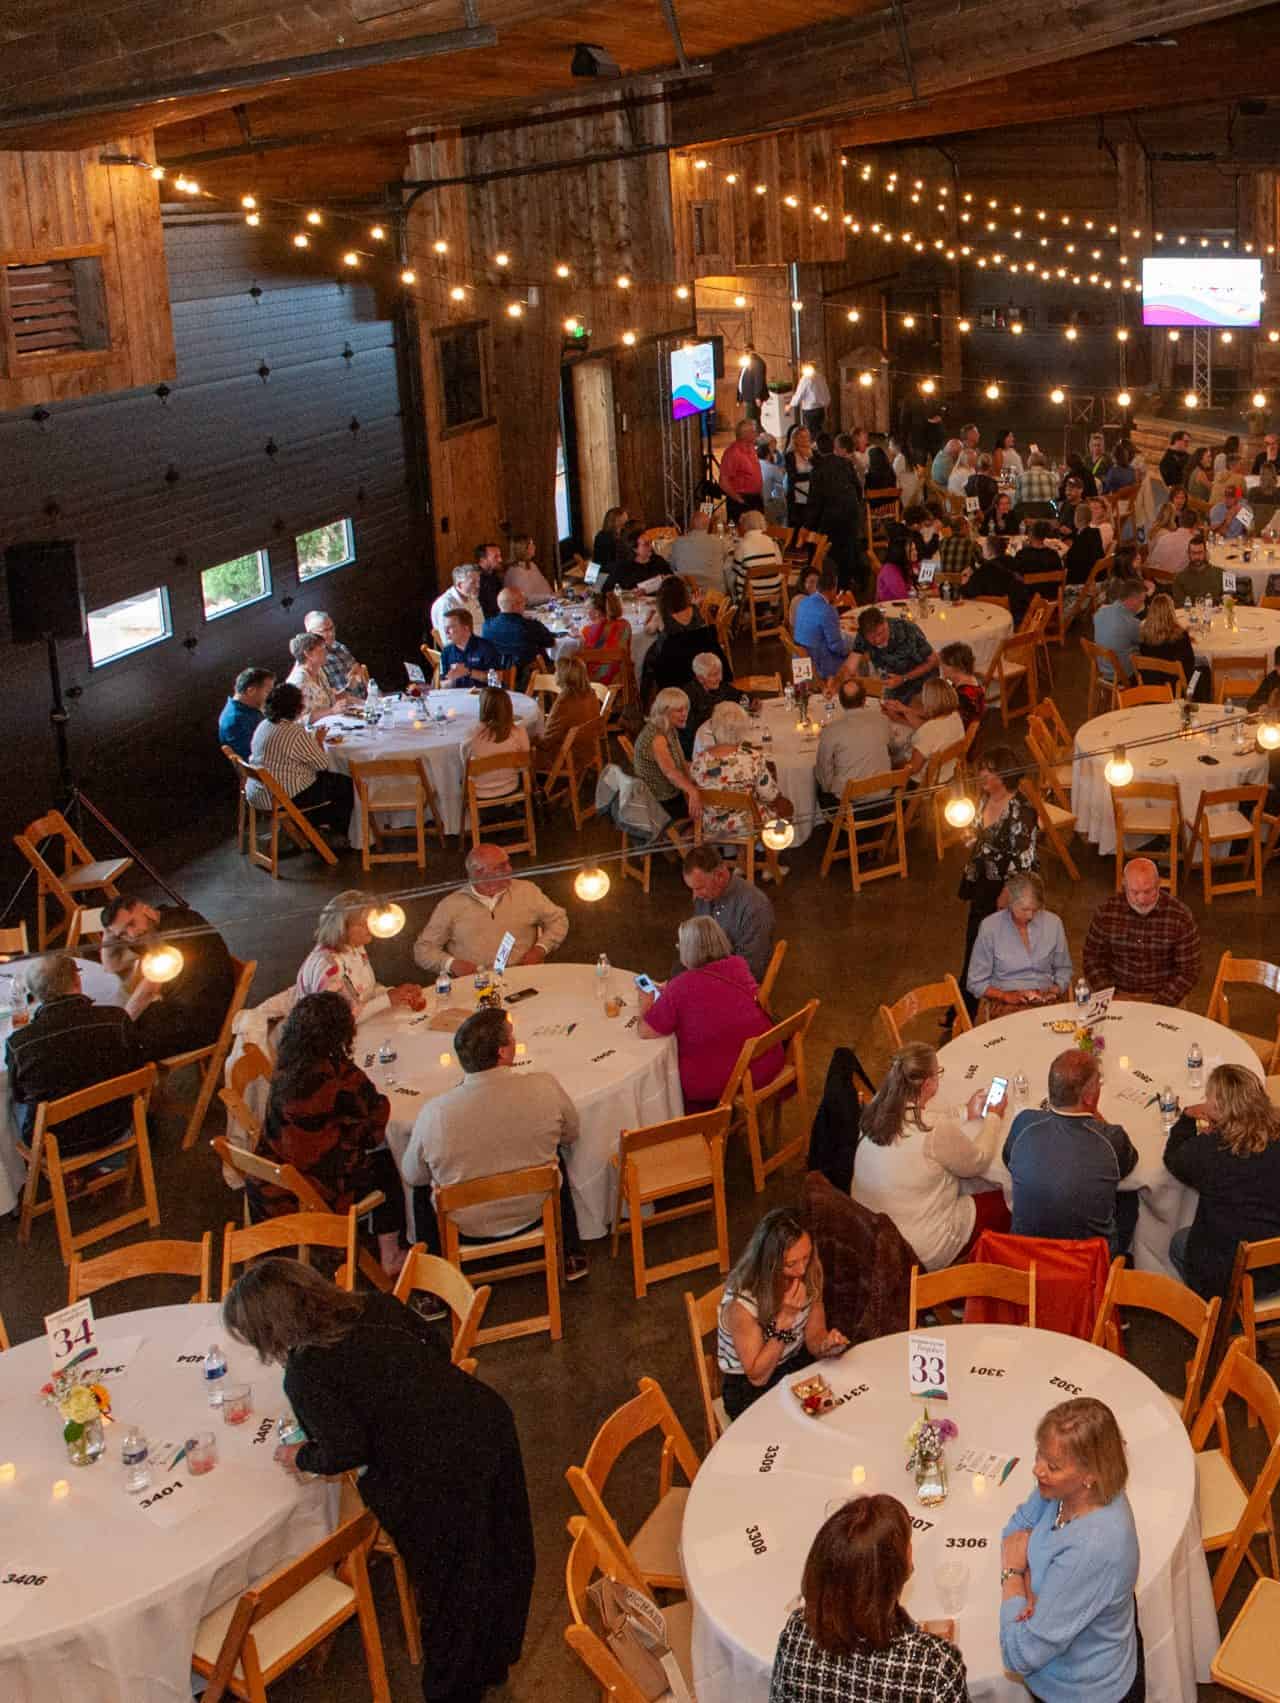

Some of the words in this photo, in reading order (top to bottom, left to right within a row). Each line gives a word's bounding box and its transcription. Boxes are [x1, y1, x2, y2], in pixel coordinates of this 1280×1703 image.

[53, 1317, 95, 1359] 34
[911, 1353, 946, 1386] 33
[969, 1365, 1007, 1378] 3301
[1048, 1375, 1084, 1396] 3302
[252, 1417, 276, 1445] 3407
[758, 1444, 780, 1473] 3309
[138, 1480, 184, 1509] 3401
[745, 1524, 768, 1556] 3308
[944, 1537, 989, 1549] 3306
[1, 1572, 49, 1586] 3406
